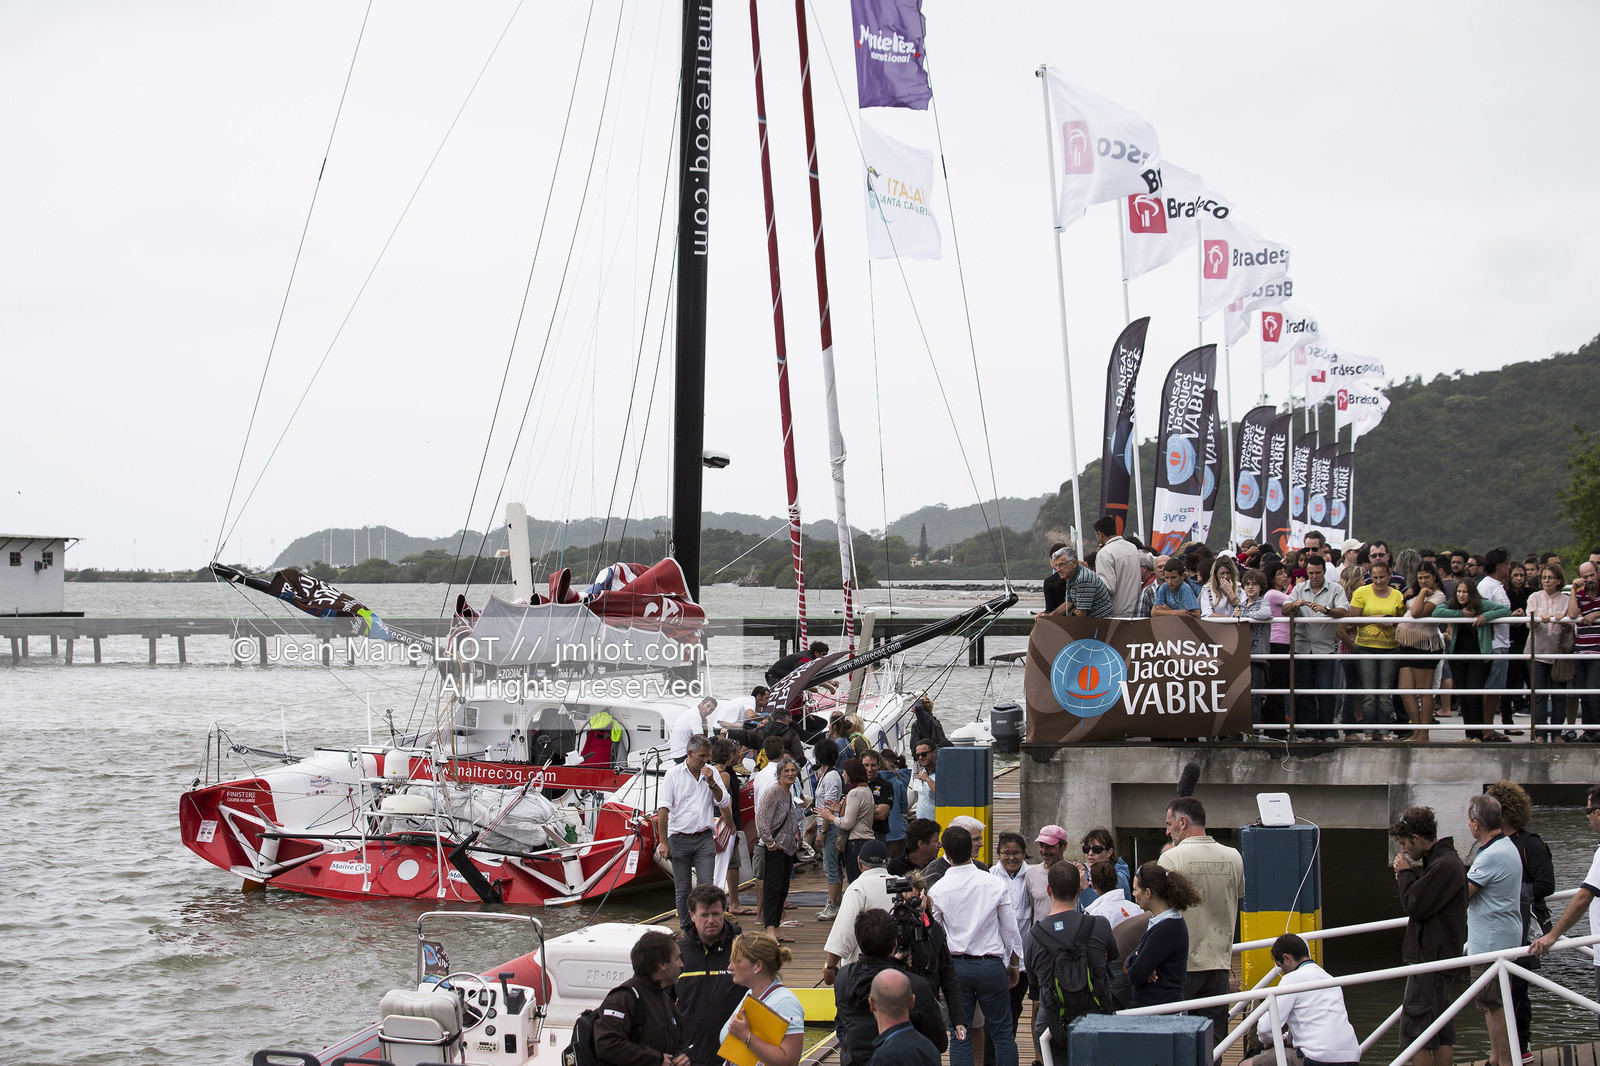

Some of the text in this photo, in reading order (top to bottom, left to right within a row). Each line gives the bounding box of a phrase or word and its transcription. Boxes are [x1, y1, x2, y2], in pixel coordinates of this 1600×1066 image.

[1166, 369, 1184, 434] TRANSAT
[1179, 371, 1207, 441] VABRE
[1249, 424, 1266, 476] VABRE
[1272, 433, 1286, 480] VABRE
[1297, 446, 1311, 489] VABRE
[1320, 458, 1331, 497] VABRE
[1335, 466, 1349, 502] VABRE
[1126, 639, 1223, 659] TRANSAT
[1118, 680, 1228, 715] VABRE
